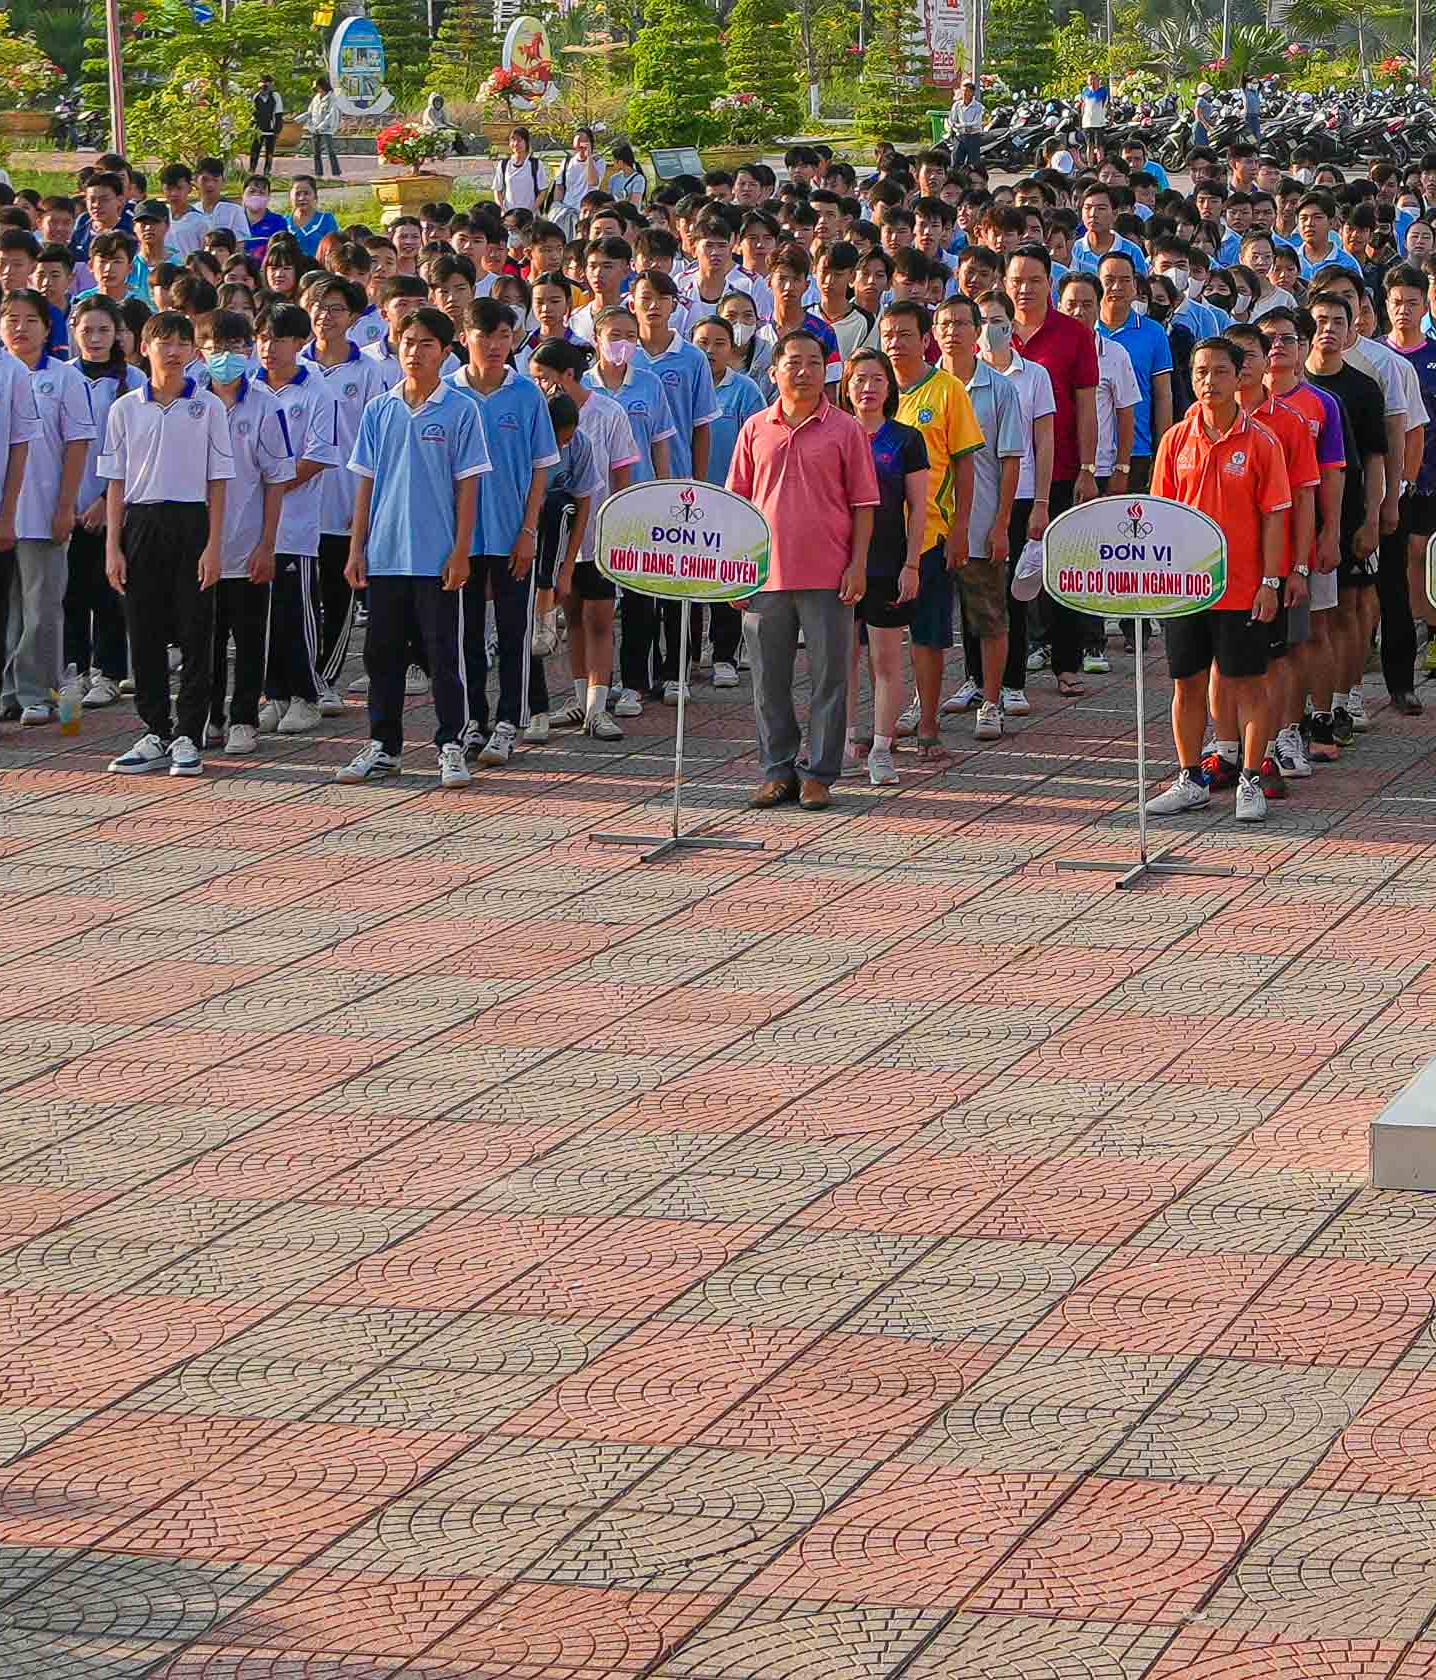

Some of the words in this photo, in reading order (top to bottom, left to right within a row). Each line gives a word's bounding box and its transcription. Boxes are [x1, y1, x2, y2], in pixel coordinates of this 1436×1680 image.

[651, 526, 696, 545] ĐƠN
[703, 531, 722, 552] VỊ
[610, 544, 639, 571] KHỐI
[680, 554, 717, 580] CHÍNH
[720, 555, 758, 585] QUYỀN
[1099, 543, 1145, 561] ĐƠN
[1153, 546, 1172, 567] VỊ
[1059, 567, 1083, 593] CÁC
[1087, 568, 1104, 593] CƠ
[1107, 571, 1139, 596] QUAN
[1142, 570, 1182, 595] NGÀNH
[1185, 573, 1212, 600] DỌC
